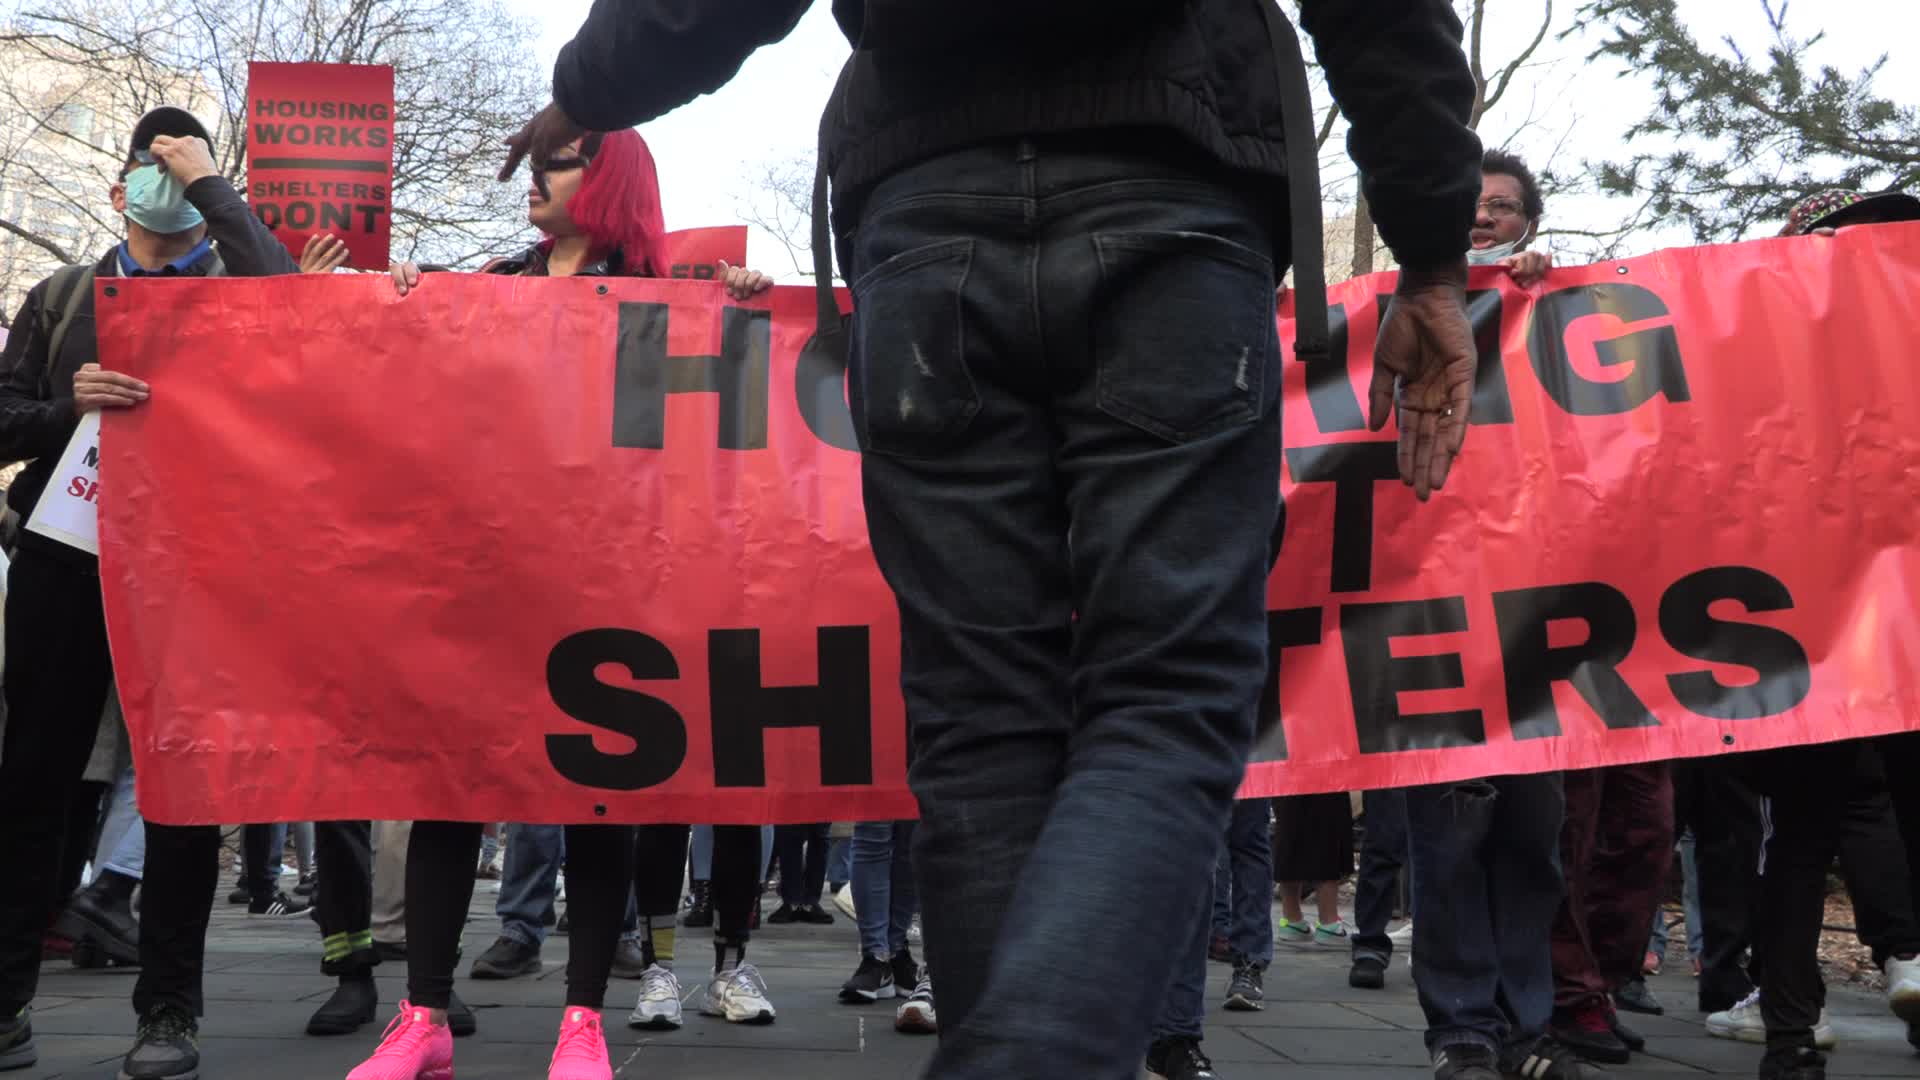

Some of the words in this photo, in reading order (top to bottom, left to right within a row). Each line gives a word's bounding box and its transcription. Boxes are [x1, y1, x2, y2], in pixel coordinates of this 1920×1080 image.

[255, 98, 388, 121] HOUSING
[254, 122, 388, 148] WORKS
[252, 181, 385, 200] SHELTERS
[545, 566, 1811, 790] SHTERS
